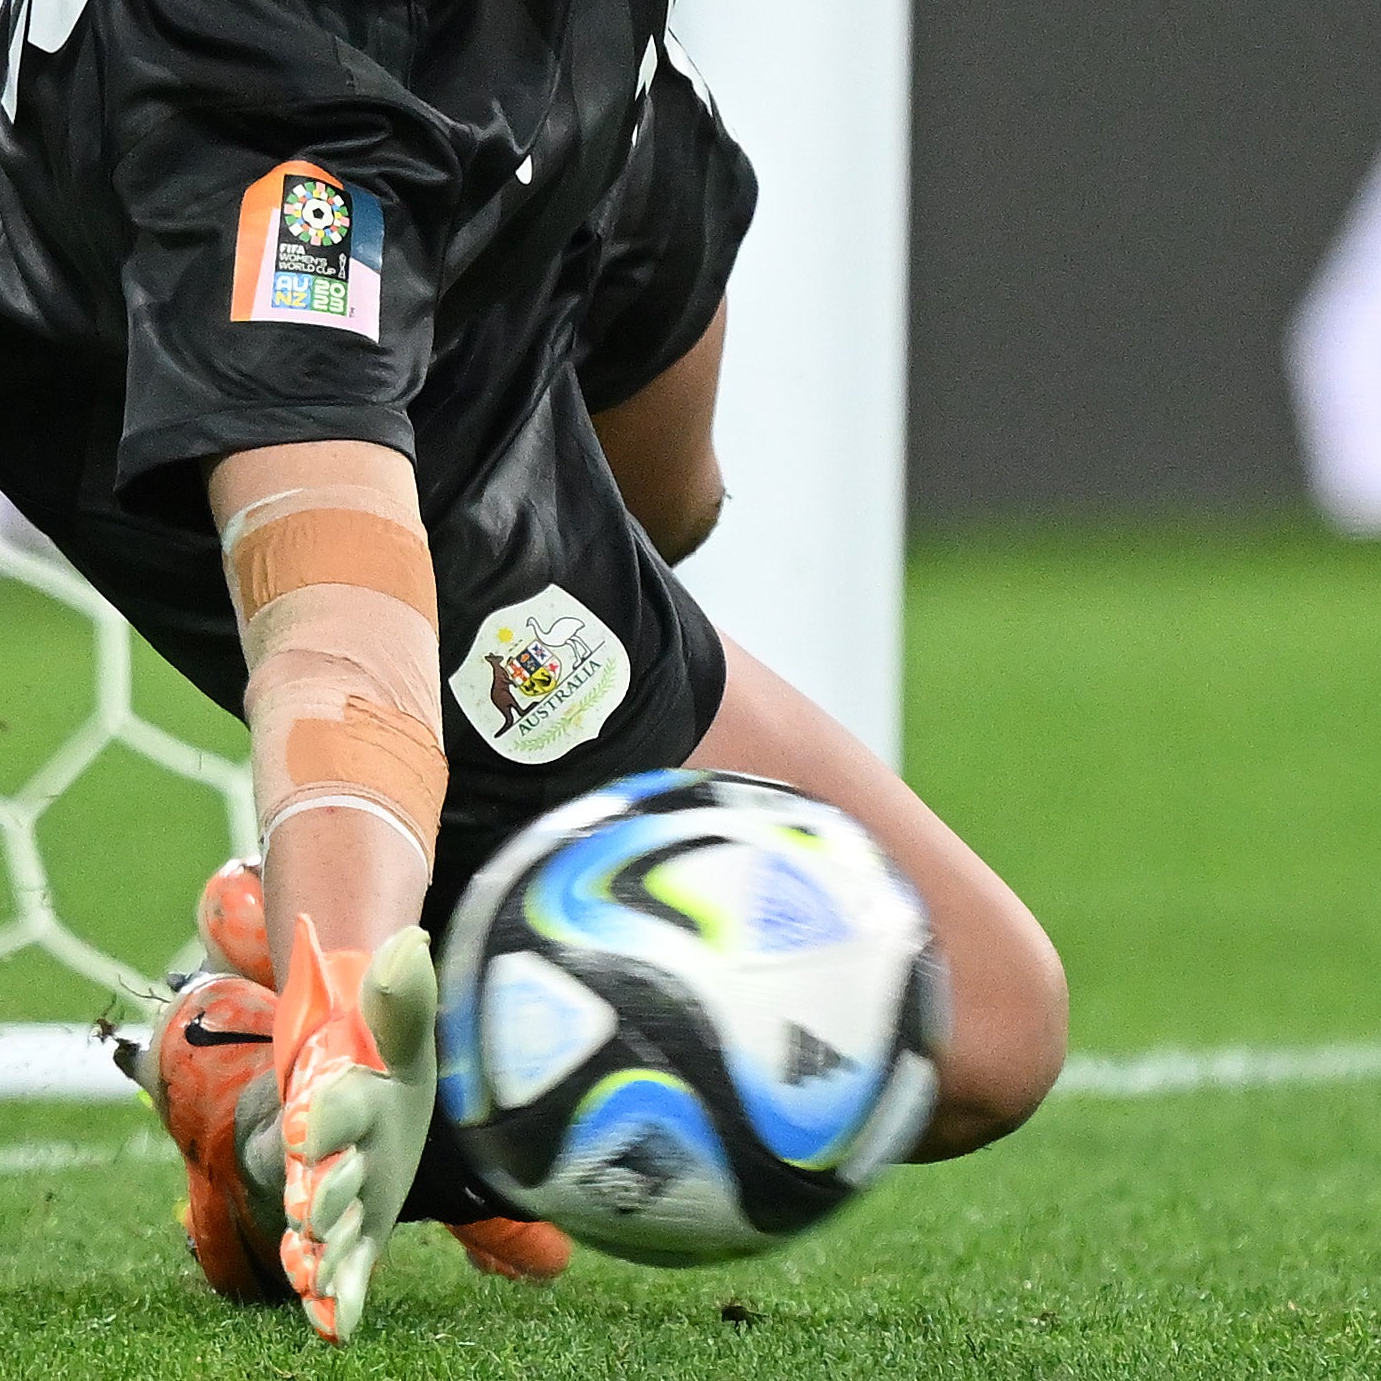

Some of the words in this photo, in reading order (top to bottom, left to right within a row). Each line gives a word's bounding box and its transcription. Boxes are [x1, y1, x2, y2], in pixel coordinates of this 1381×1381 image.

[279, 243, 306, 255] FIFA
[279, 262, 315, 272] WORLD
[315, 266, 337, 275] CUP
[276, 275, 308, 292] AU
[313, 279, 346, 298] 20
[275, 291, 308, 307] NZ
[312, 295, 345, 313] 23
[517, 659, 602, 736] AUSTRALIA
